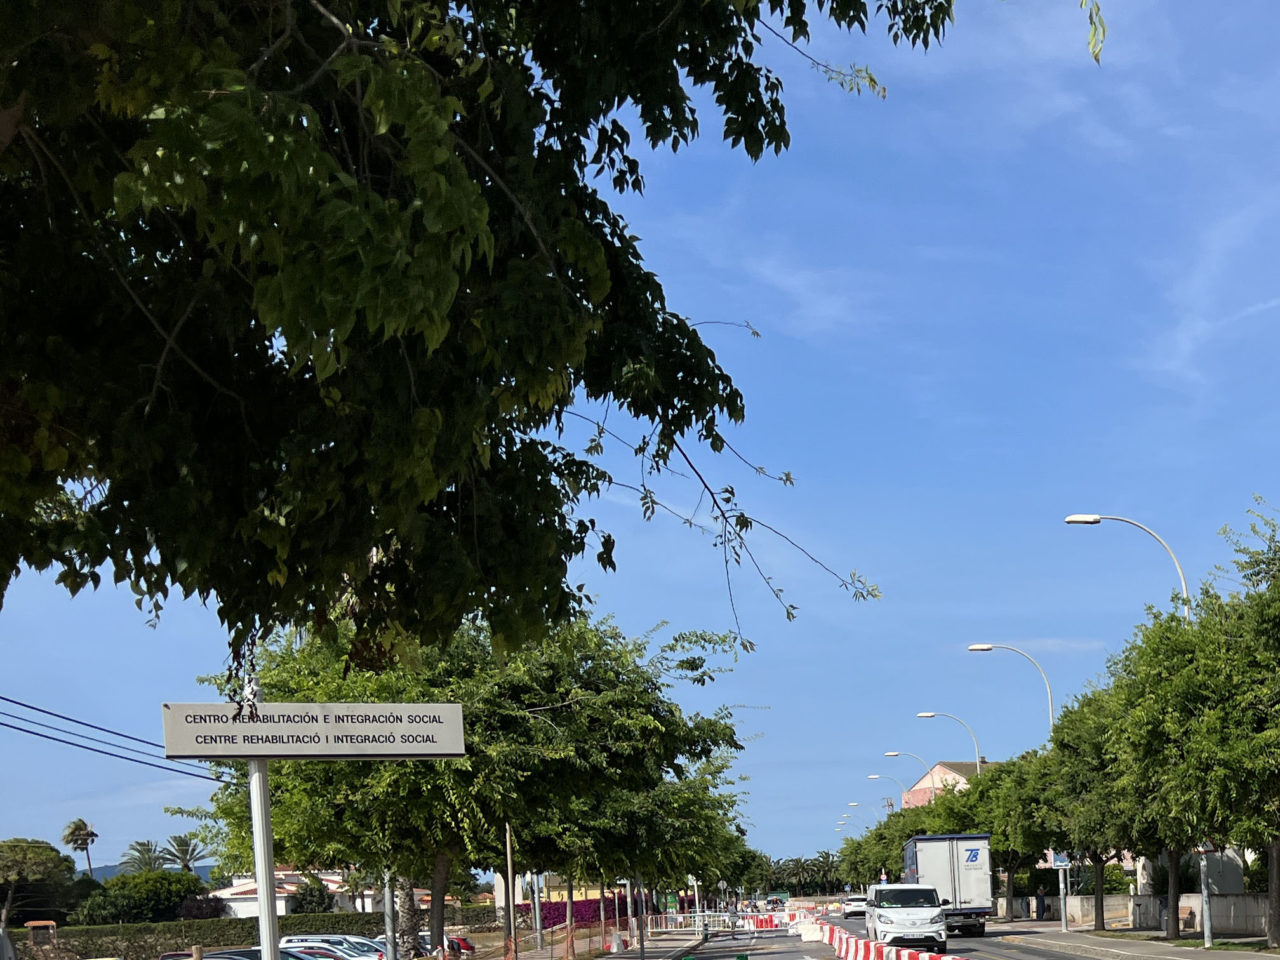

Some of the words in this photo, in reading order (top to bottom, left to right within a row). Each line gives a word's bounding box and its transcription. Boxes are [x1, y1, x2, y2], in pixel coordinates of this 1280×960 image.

[185, 714, 228, 724] CENTRO
[323, 714, 330, 723] E
[334, 712, 403, 724] INTEGRACIÓN
[407, 714, 444, 724] SOCIAL
[195, 735, 237, 744] CENTRE
[243, 733, 320, 744] REHABILITACIÓ
[334, 732, 395, 744] INTEGRACIÓ
[400, 734, 437, 744] SOCIAL
